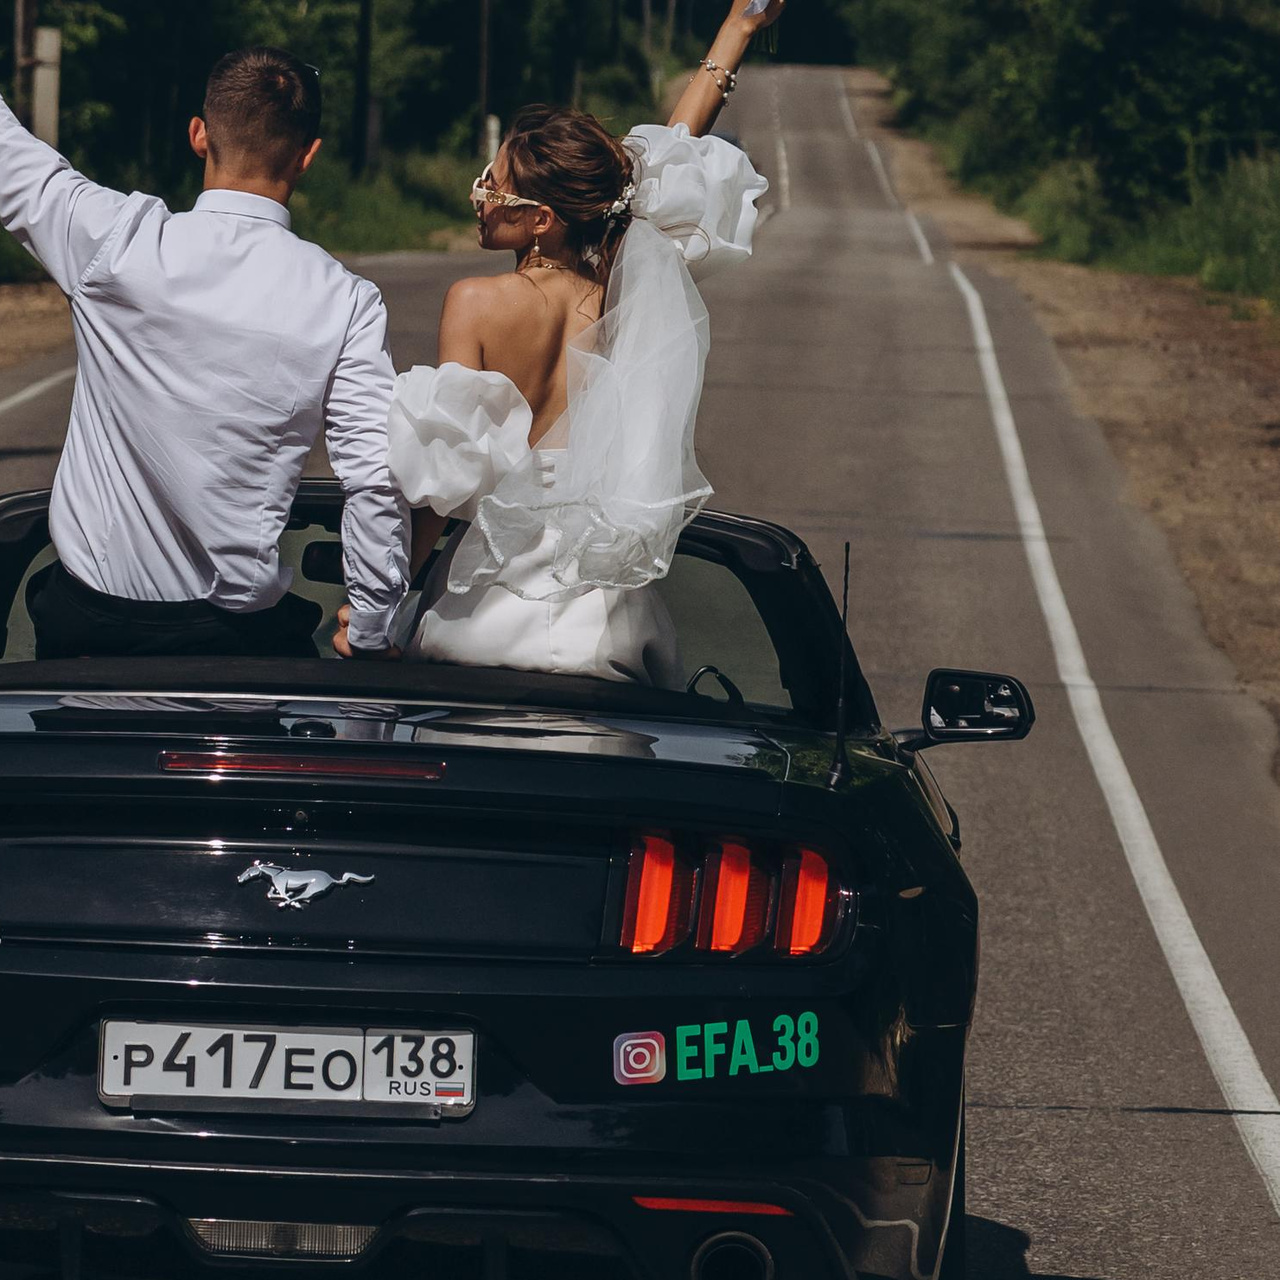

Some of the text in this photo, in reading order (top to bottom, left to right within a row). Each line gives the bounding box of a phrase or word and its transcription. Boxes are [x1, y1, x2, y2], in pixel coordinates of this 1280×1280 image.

[372, 1035, 456, 1079] 138
[676, 1011, 820, 1081] EFA_38
[389, 1081, 431, 1096] RUS
